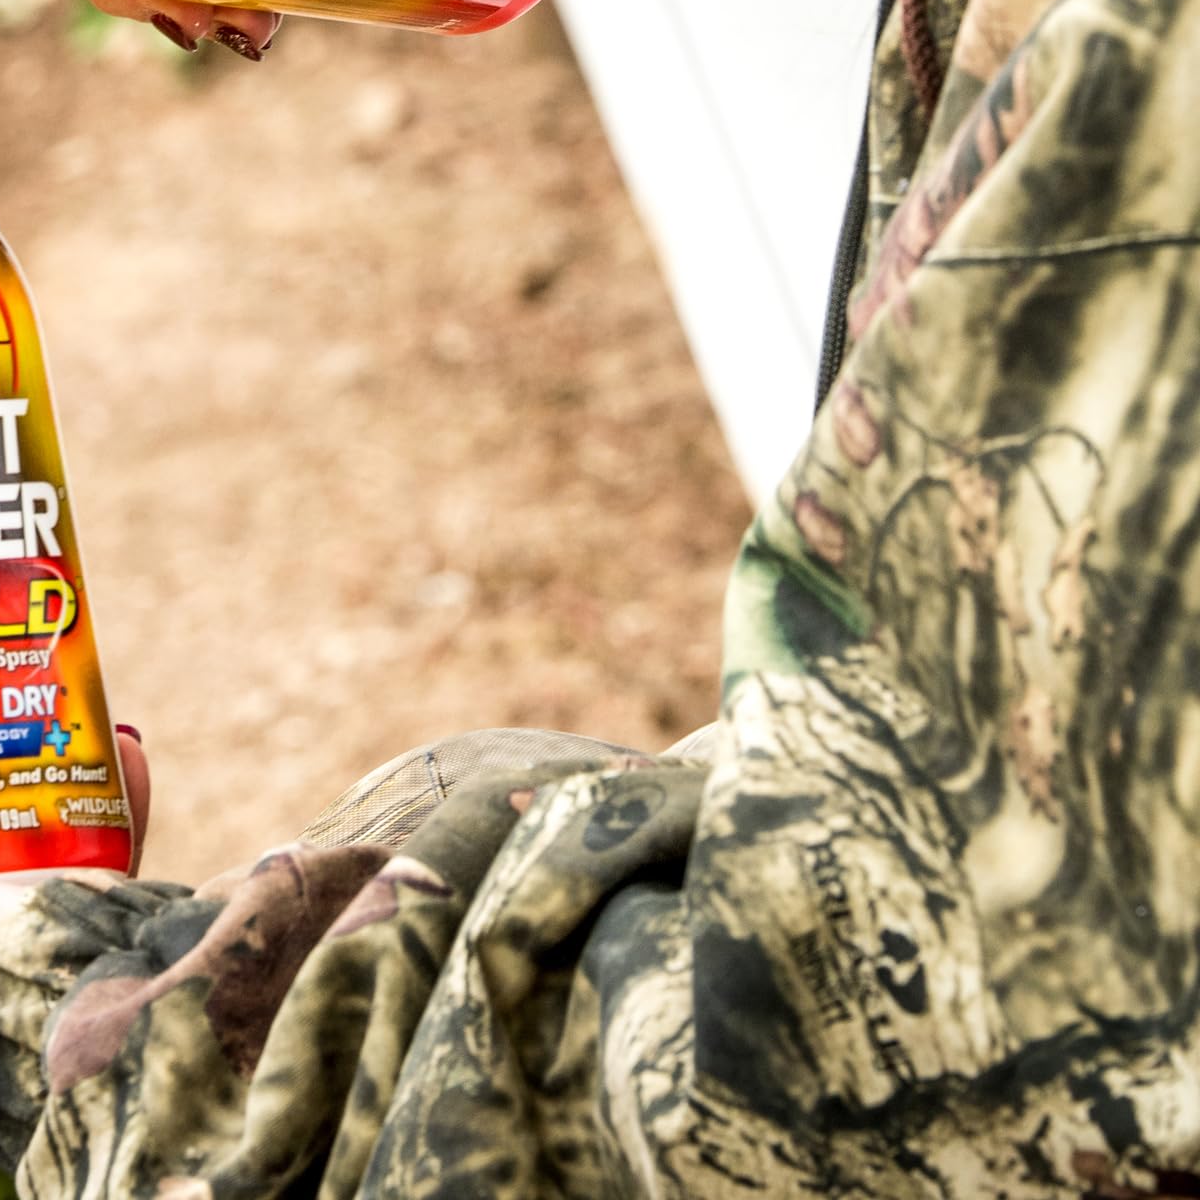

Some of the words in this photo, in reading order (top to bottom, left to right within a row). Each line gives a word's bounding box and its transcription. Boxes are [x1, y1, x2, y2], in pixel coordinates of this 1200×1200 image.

[1, 683, 58, 719] DRY
[10, 767, 41, 786] and
[45, 765, 68, 782] Go
[70, 765, 108, 783] Hunt!
